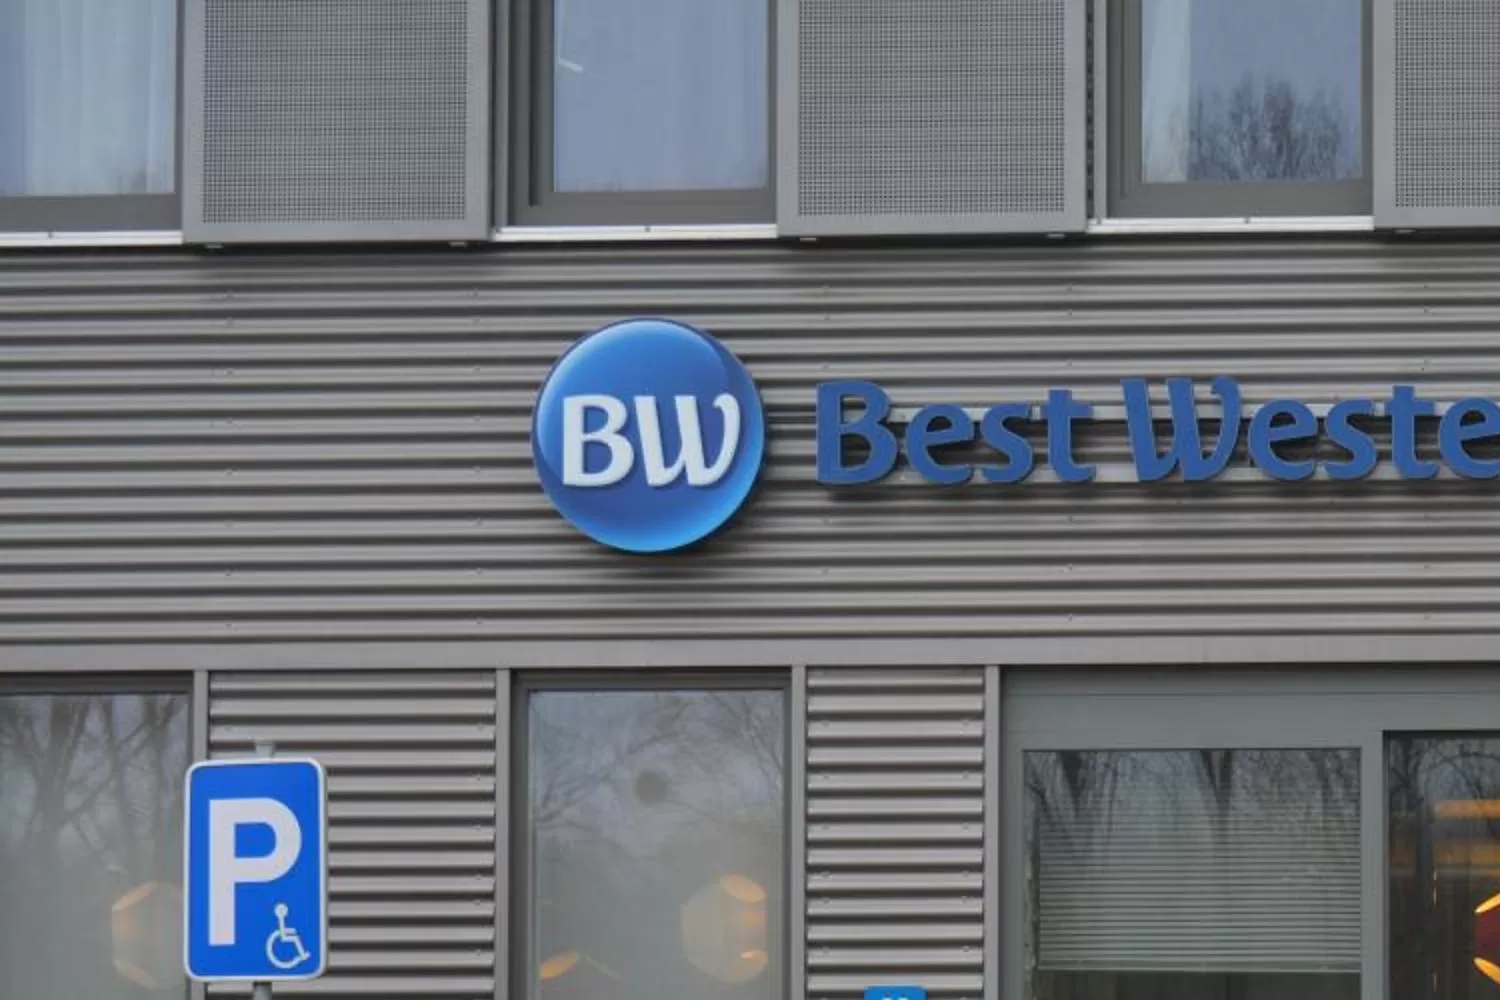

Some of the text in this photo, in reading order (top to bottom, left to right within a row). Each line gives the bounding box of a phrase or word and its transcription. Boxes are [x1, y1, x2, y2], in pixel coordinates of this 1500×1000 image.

[562, 393, 742, 488] BW
[814, 379, 1097, 486] Best
[208, 797, 302, 947] P
